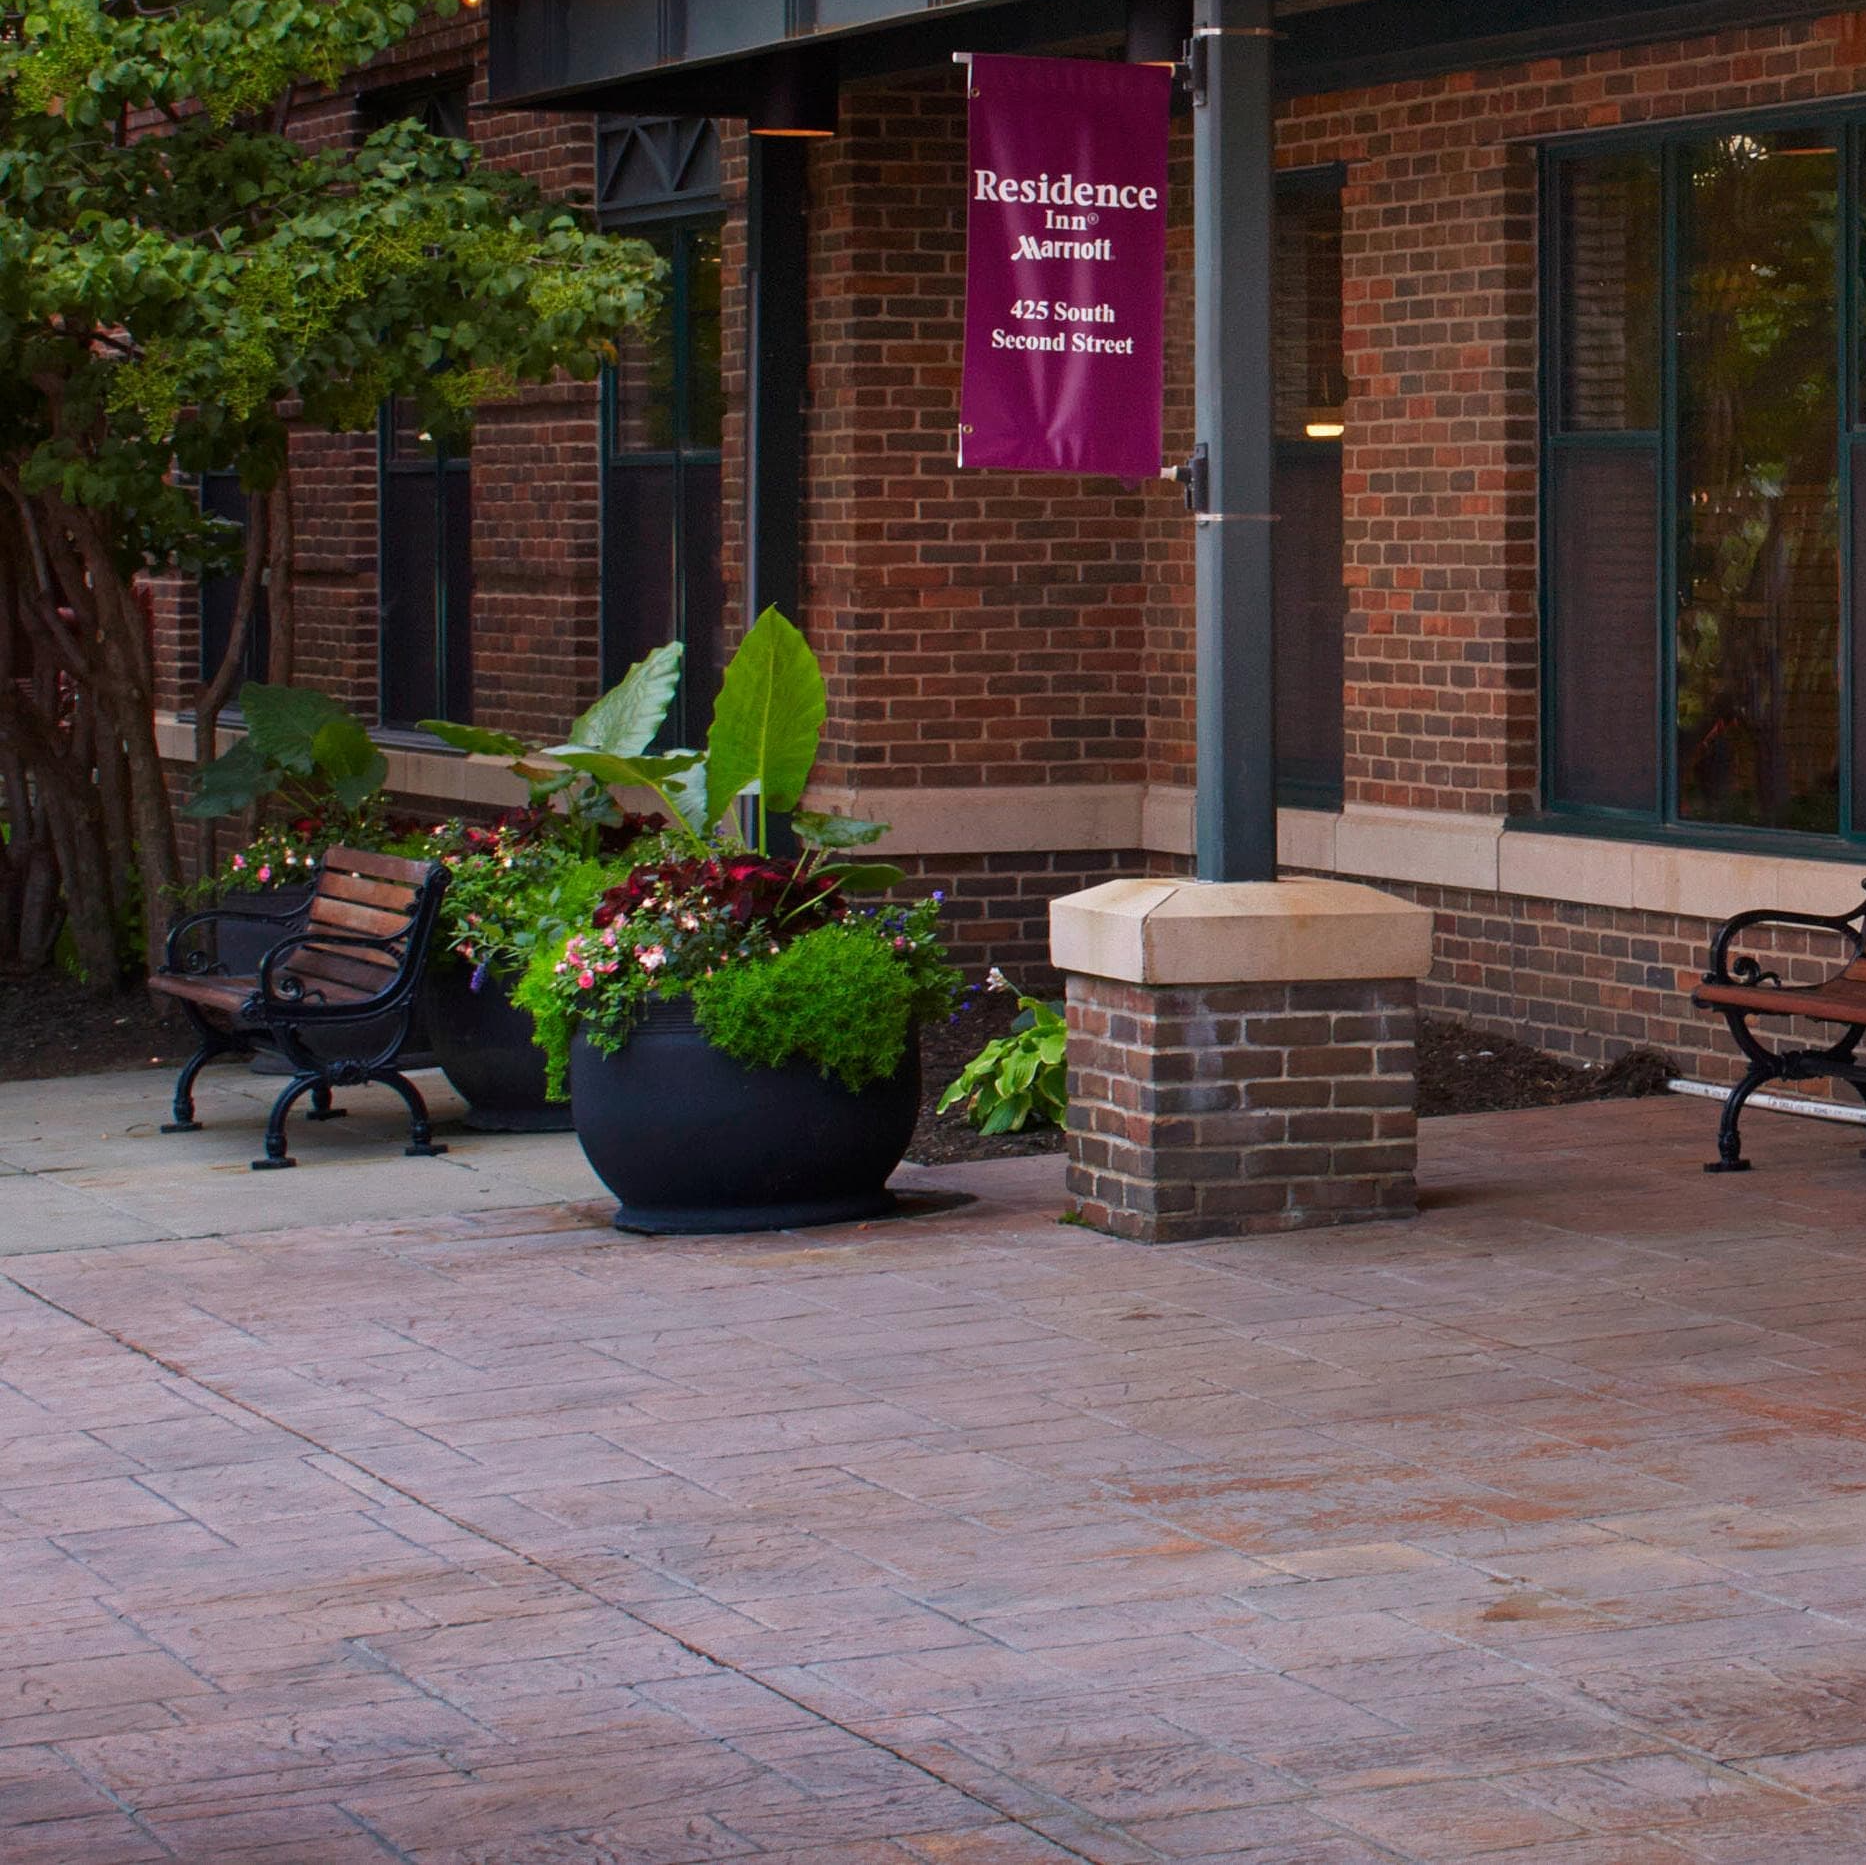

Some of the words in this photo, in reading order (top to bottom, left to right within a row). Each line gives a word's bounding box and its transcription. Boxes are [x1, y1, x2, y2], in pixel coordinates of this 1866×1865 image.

[974, 169, 1158, 210] Residence
[1010, 235, 1111, 262] Marriott
[1009, 299, 1049, 322] 425
[1054, 302, 1116, 324] South
[991, 328, 1066, 353] Second
[1071, 332, 1135, 355] Street
